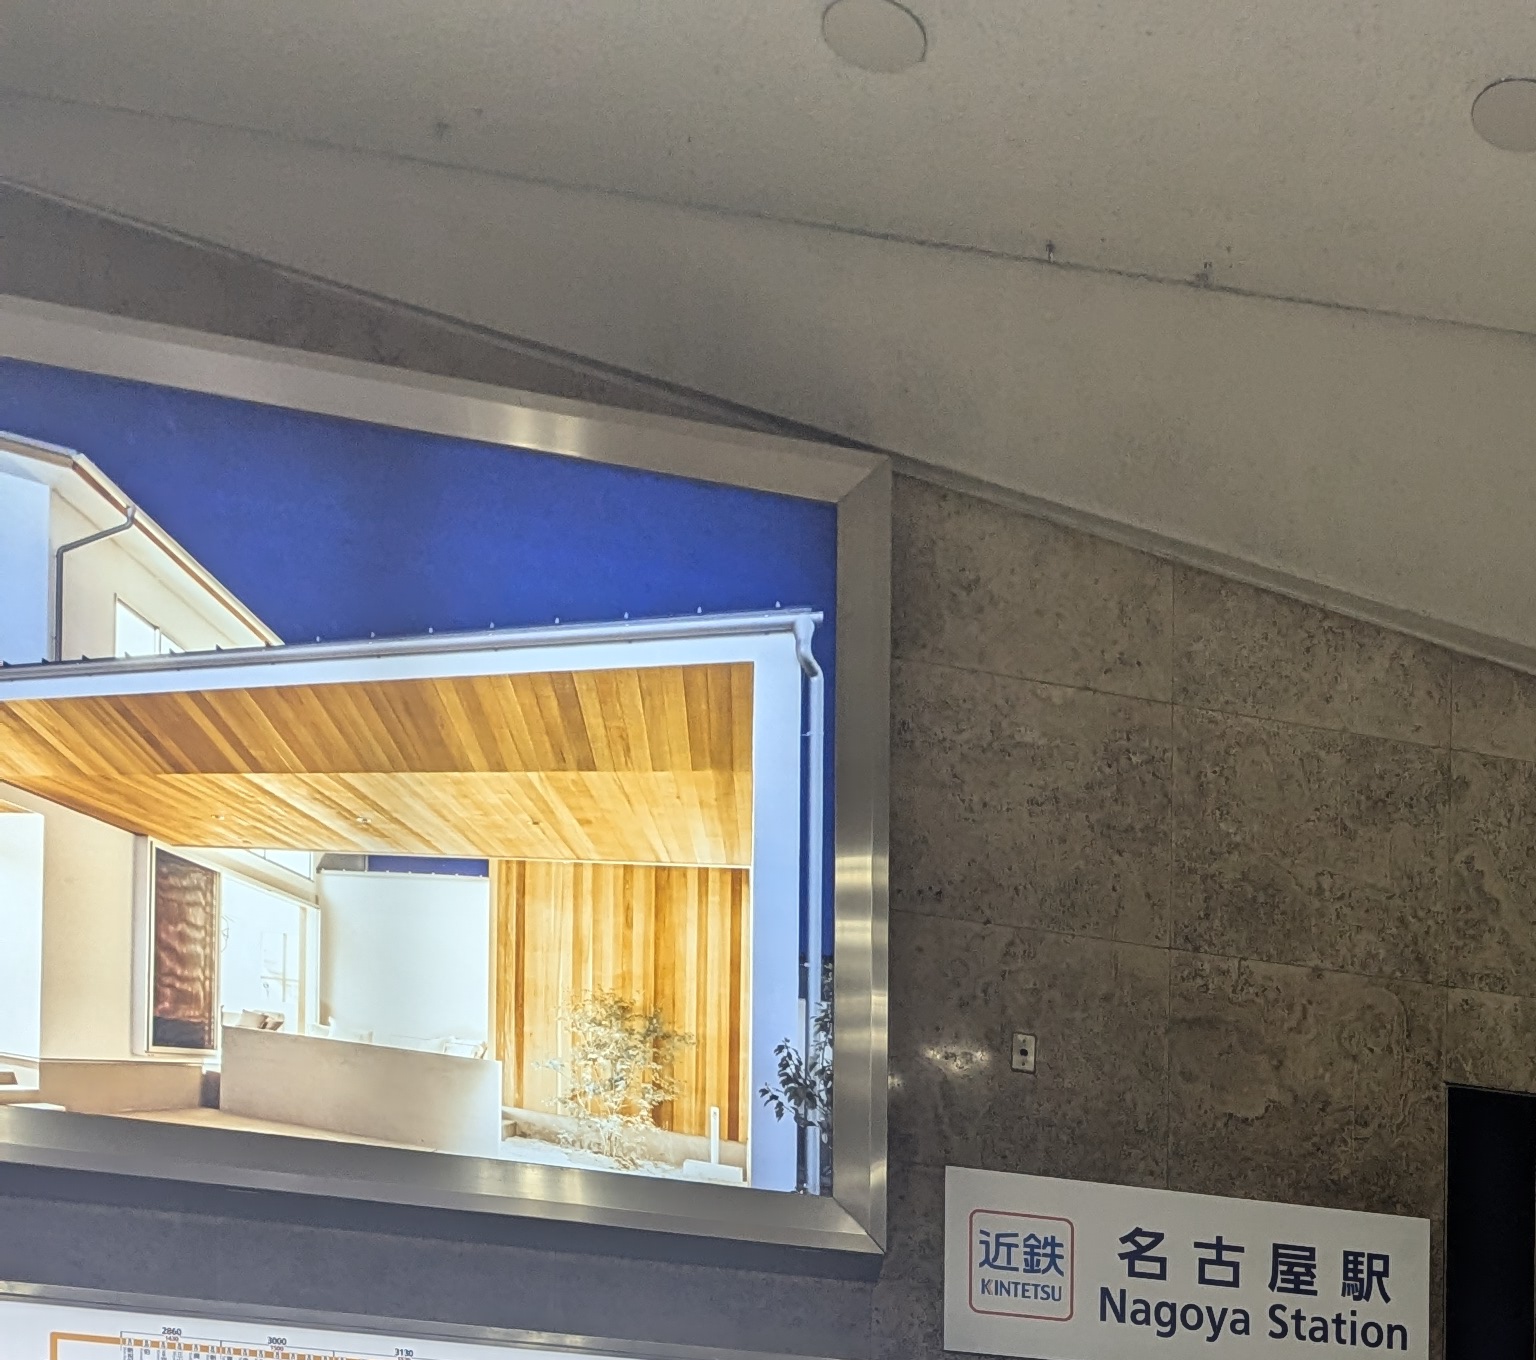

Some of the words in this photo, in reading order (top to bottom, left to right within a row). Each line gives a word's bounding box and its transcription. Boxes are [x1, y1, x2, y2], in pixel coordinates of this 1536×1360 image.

[979, 1229, 1065, 1277] 近鉄
[1118, 1227, 1391, 1304] 名古屋駅
[981, 1279, 1062, 1302] KINTETSU
[1100, 1287, 1250, 1343] Nagoya
[1269, 1304, 1407, 1351] Station
